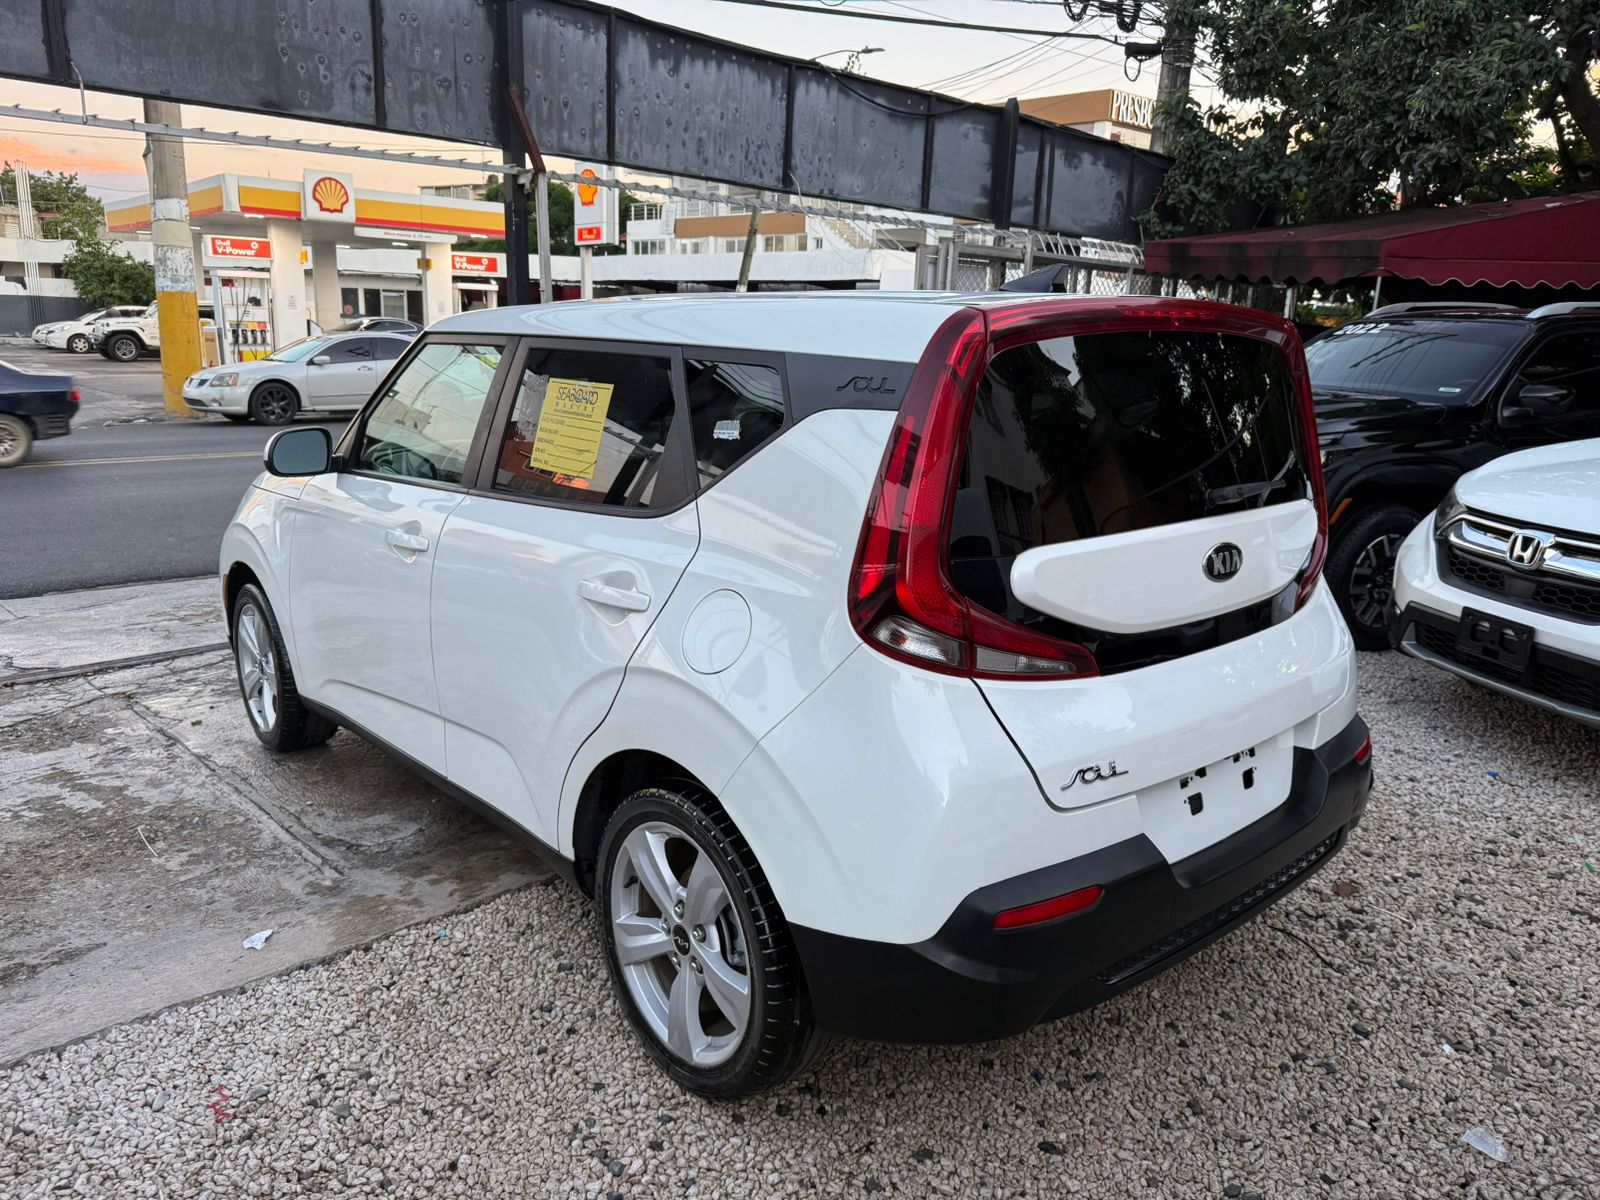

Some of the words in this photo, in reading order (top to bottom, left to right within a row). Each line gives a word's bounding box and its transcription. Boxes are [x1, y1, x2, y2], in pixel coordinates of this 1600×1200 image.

[216, 245, 257, 256] V-Power
[1332, 322, 1391, 336] 2022
[556, 386, 599, 406] SEABOARD
[1211, 549, 1240, 575] KIA
